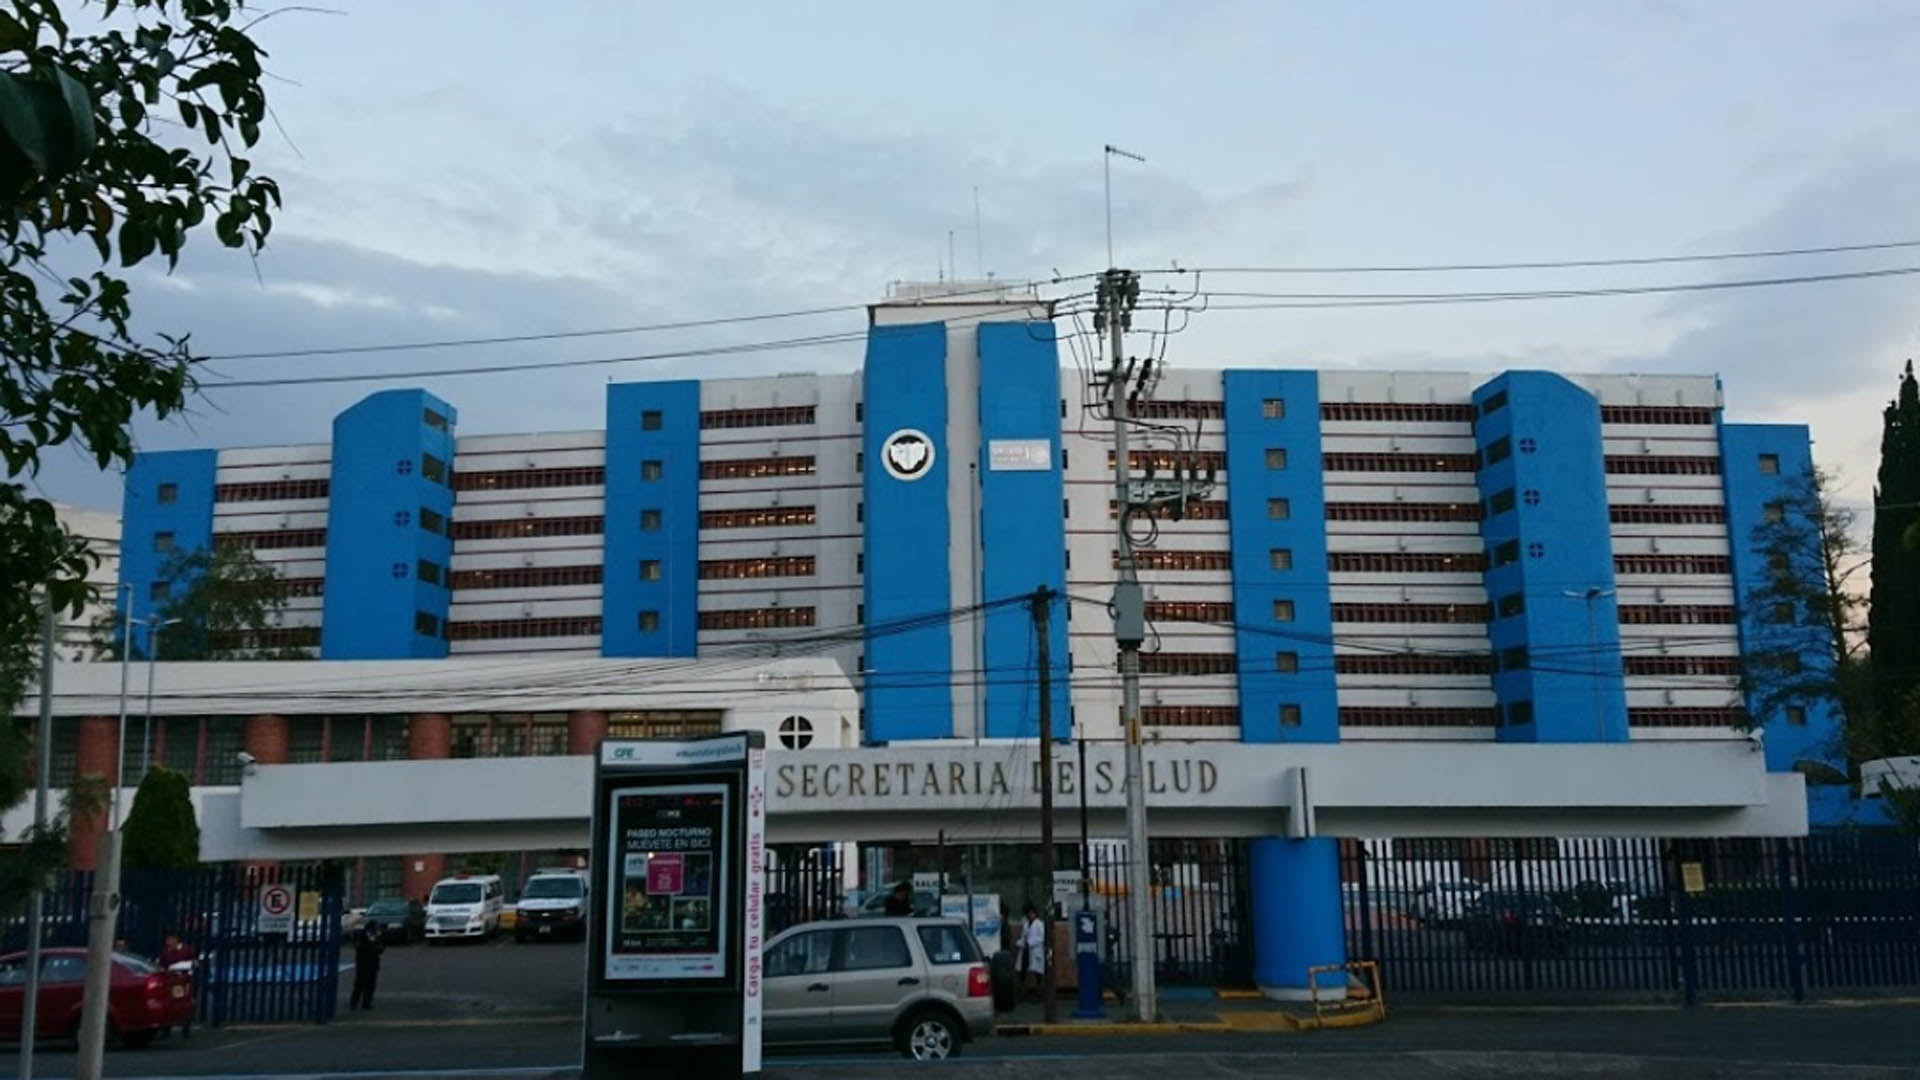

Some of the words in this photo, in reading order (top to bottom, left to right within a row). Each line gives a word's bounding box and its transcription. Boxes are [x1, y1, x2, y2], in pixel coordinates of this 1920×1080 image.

[777, 762, 1010, 799] SECRETARIA
[1096, 760, 1218, 795] SLUD
[627, 828, 657, 838] PASEO
[659, 827, 712, 838] NOCTURNO
[674, 838, 688, 848] EN
[749, 831, 762, 872] gratis
[747, 880, 760, 928] celular
[748, 935, 758, 949] tu
[746, 956, 760, 997] Carga
